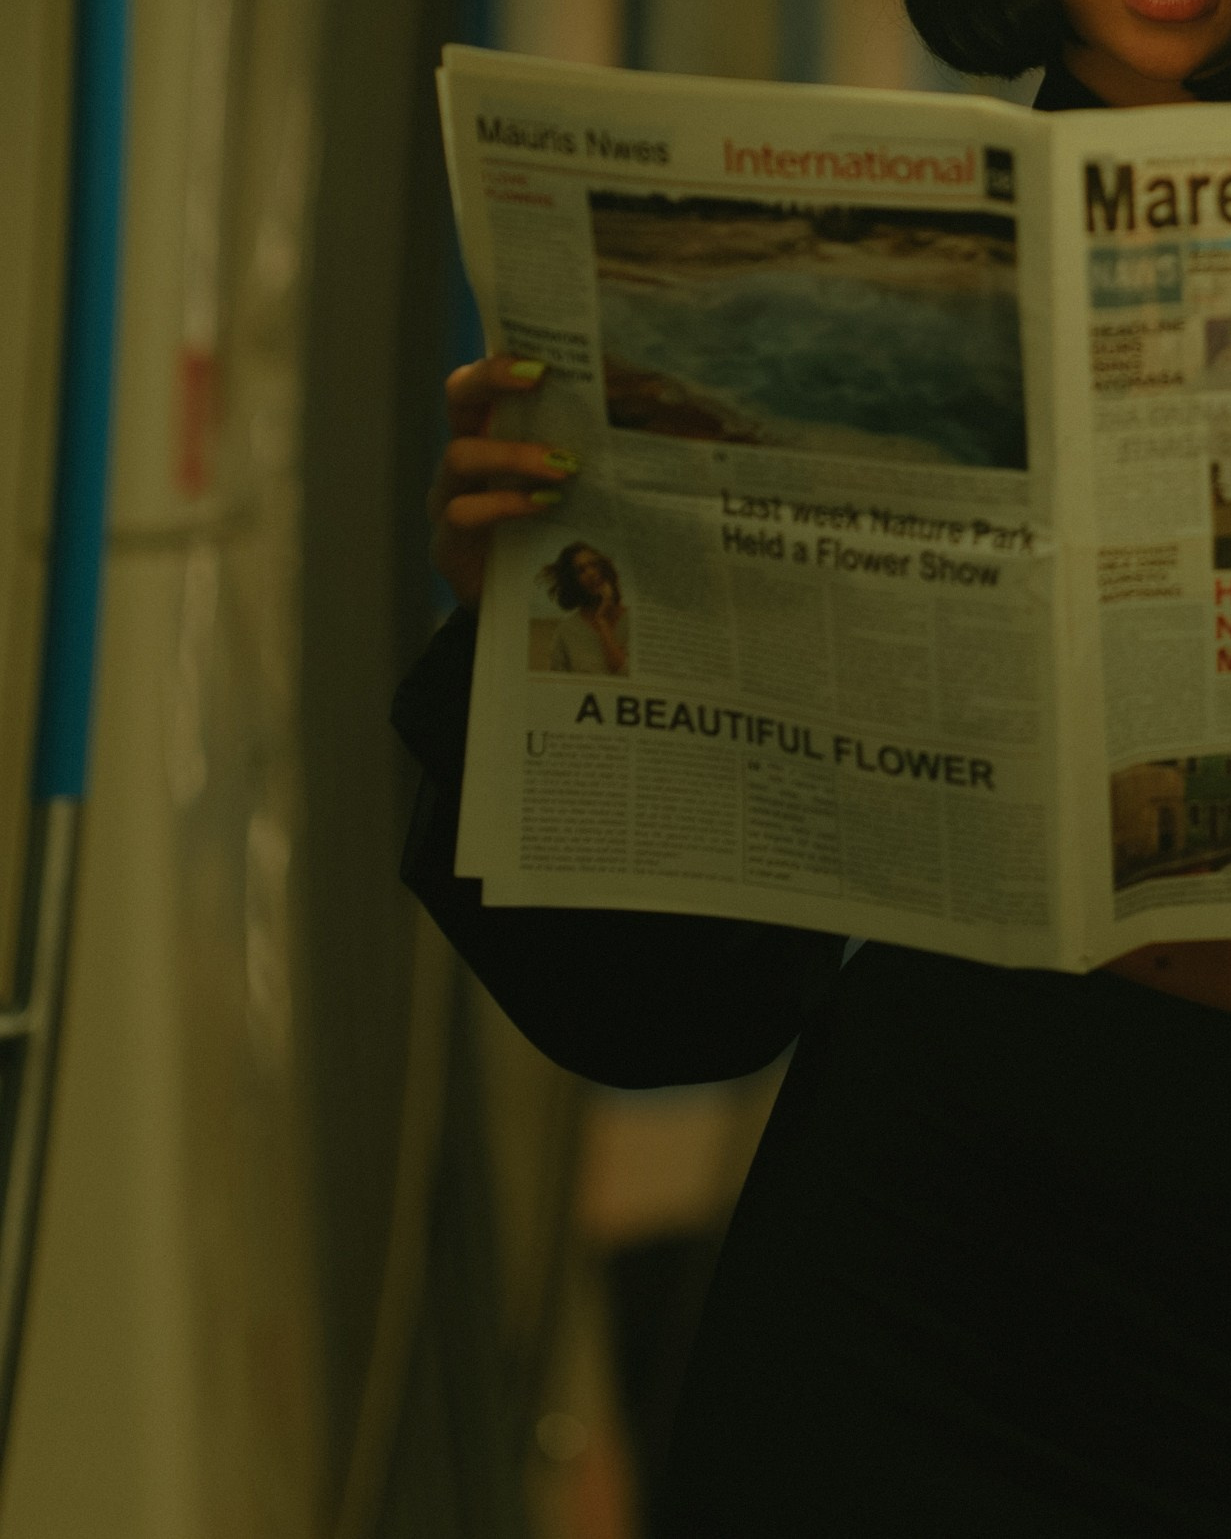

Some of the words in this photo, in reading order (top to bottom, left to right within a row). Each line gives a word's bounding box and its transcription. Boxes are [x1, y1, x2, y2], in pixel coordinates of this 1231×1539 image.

[476, 115, 577, 156] Mauris
[586, 127, 670, 165] Nwes
[725, 139, 977, 187] International
[722, 488, 784, 521] Last
[791, 498, 861, 531] week
[871, 504, 965, 545] Nature
[972, 517, 1036, 553] Park
[722, 524, 785, 560] Held
[792, 541, 809, 564] a
[816, 536, 912, 577] Flower
[918, 548, 1000, 586] Show
[574, 693, 604, 725] A
[614, 695, 823, 760] BEAUTIFUL
[832, 734, 997, 790] FLOWER
